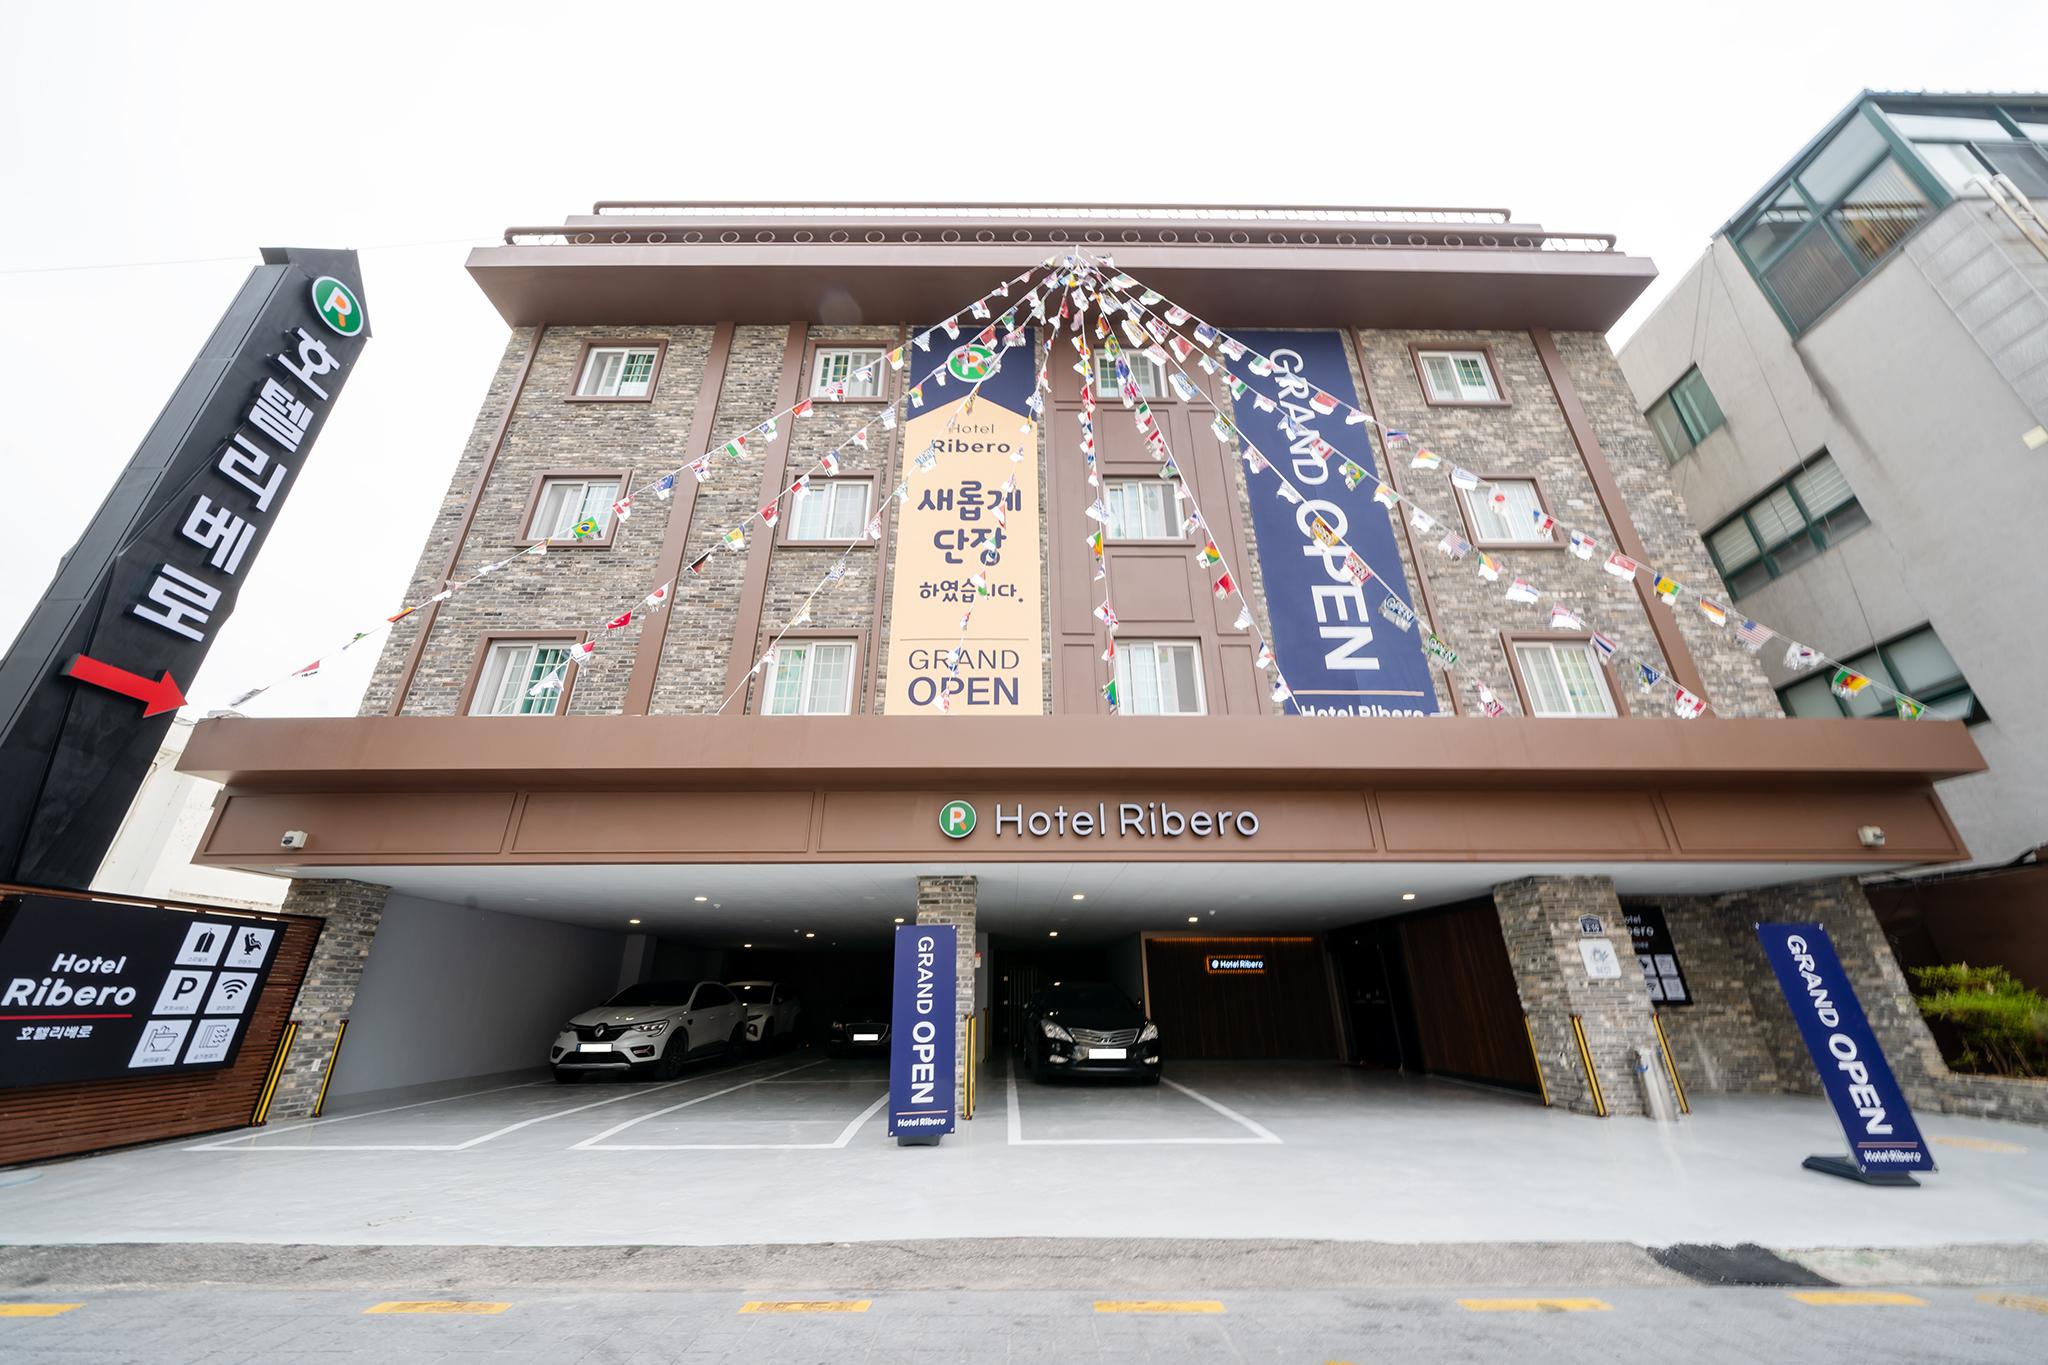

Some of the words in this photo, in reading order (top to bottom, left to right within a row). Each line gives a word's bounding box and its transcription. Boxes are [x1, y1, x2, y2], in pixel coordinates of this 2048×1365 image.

[1269, 348, 1329, 485] GRAND
[932, 439, 1010, 453] Ribero
[133, 327, 340, 642] 호텔리베로
[917, 480, 1022, 521] 새롭게
[934, 527, 1007, 566] 단장
[1296, 499, 1380, 671] OPEN
[909, 649, 1019, 670] GRAND
[908, 676, 1018, 706] OPEN
[995, 803, 1106, 836] Hotel
[1119, 803, 1260, 836] Ribero
[52, 953, 127, 974] Hotel
[916, 936, 935, 1015] GRAND
[1220, 960, 1239, 969] Hotel
[1240, 959, 1264, 969] Ribero
[0, 977, 137, 1007] Ribero
[1787, 934, 1840, 1028] GRAND
[1828, 1033, 1893, 1135] OPEN
[911, 1021, 936, 1104] OPEN
[897, 1118, 920, 1127] Hotel
[920, 1117, 946, 1126] Ribero
